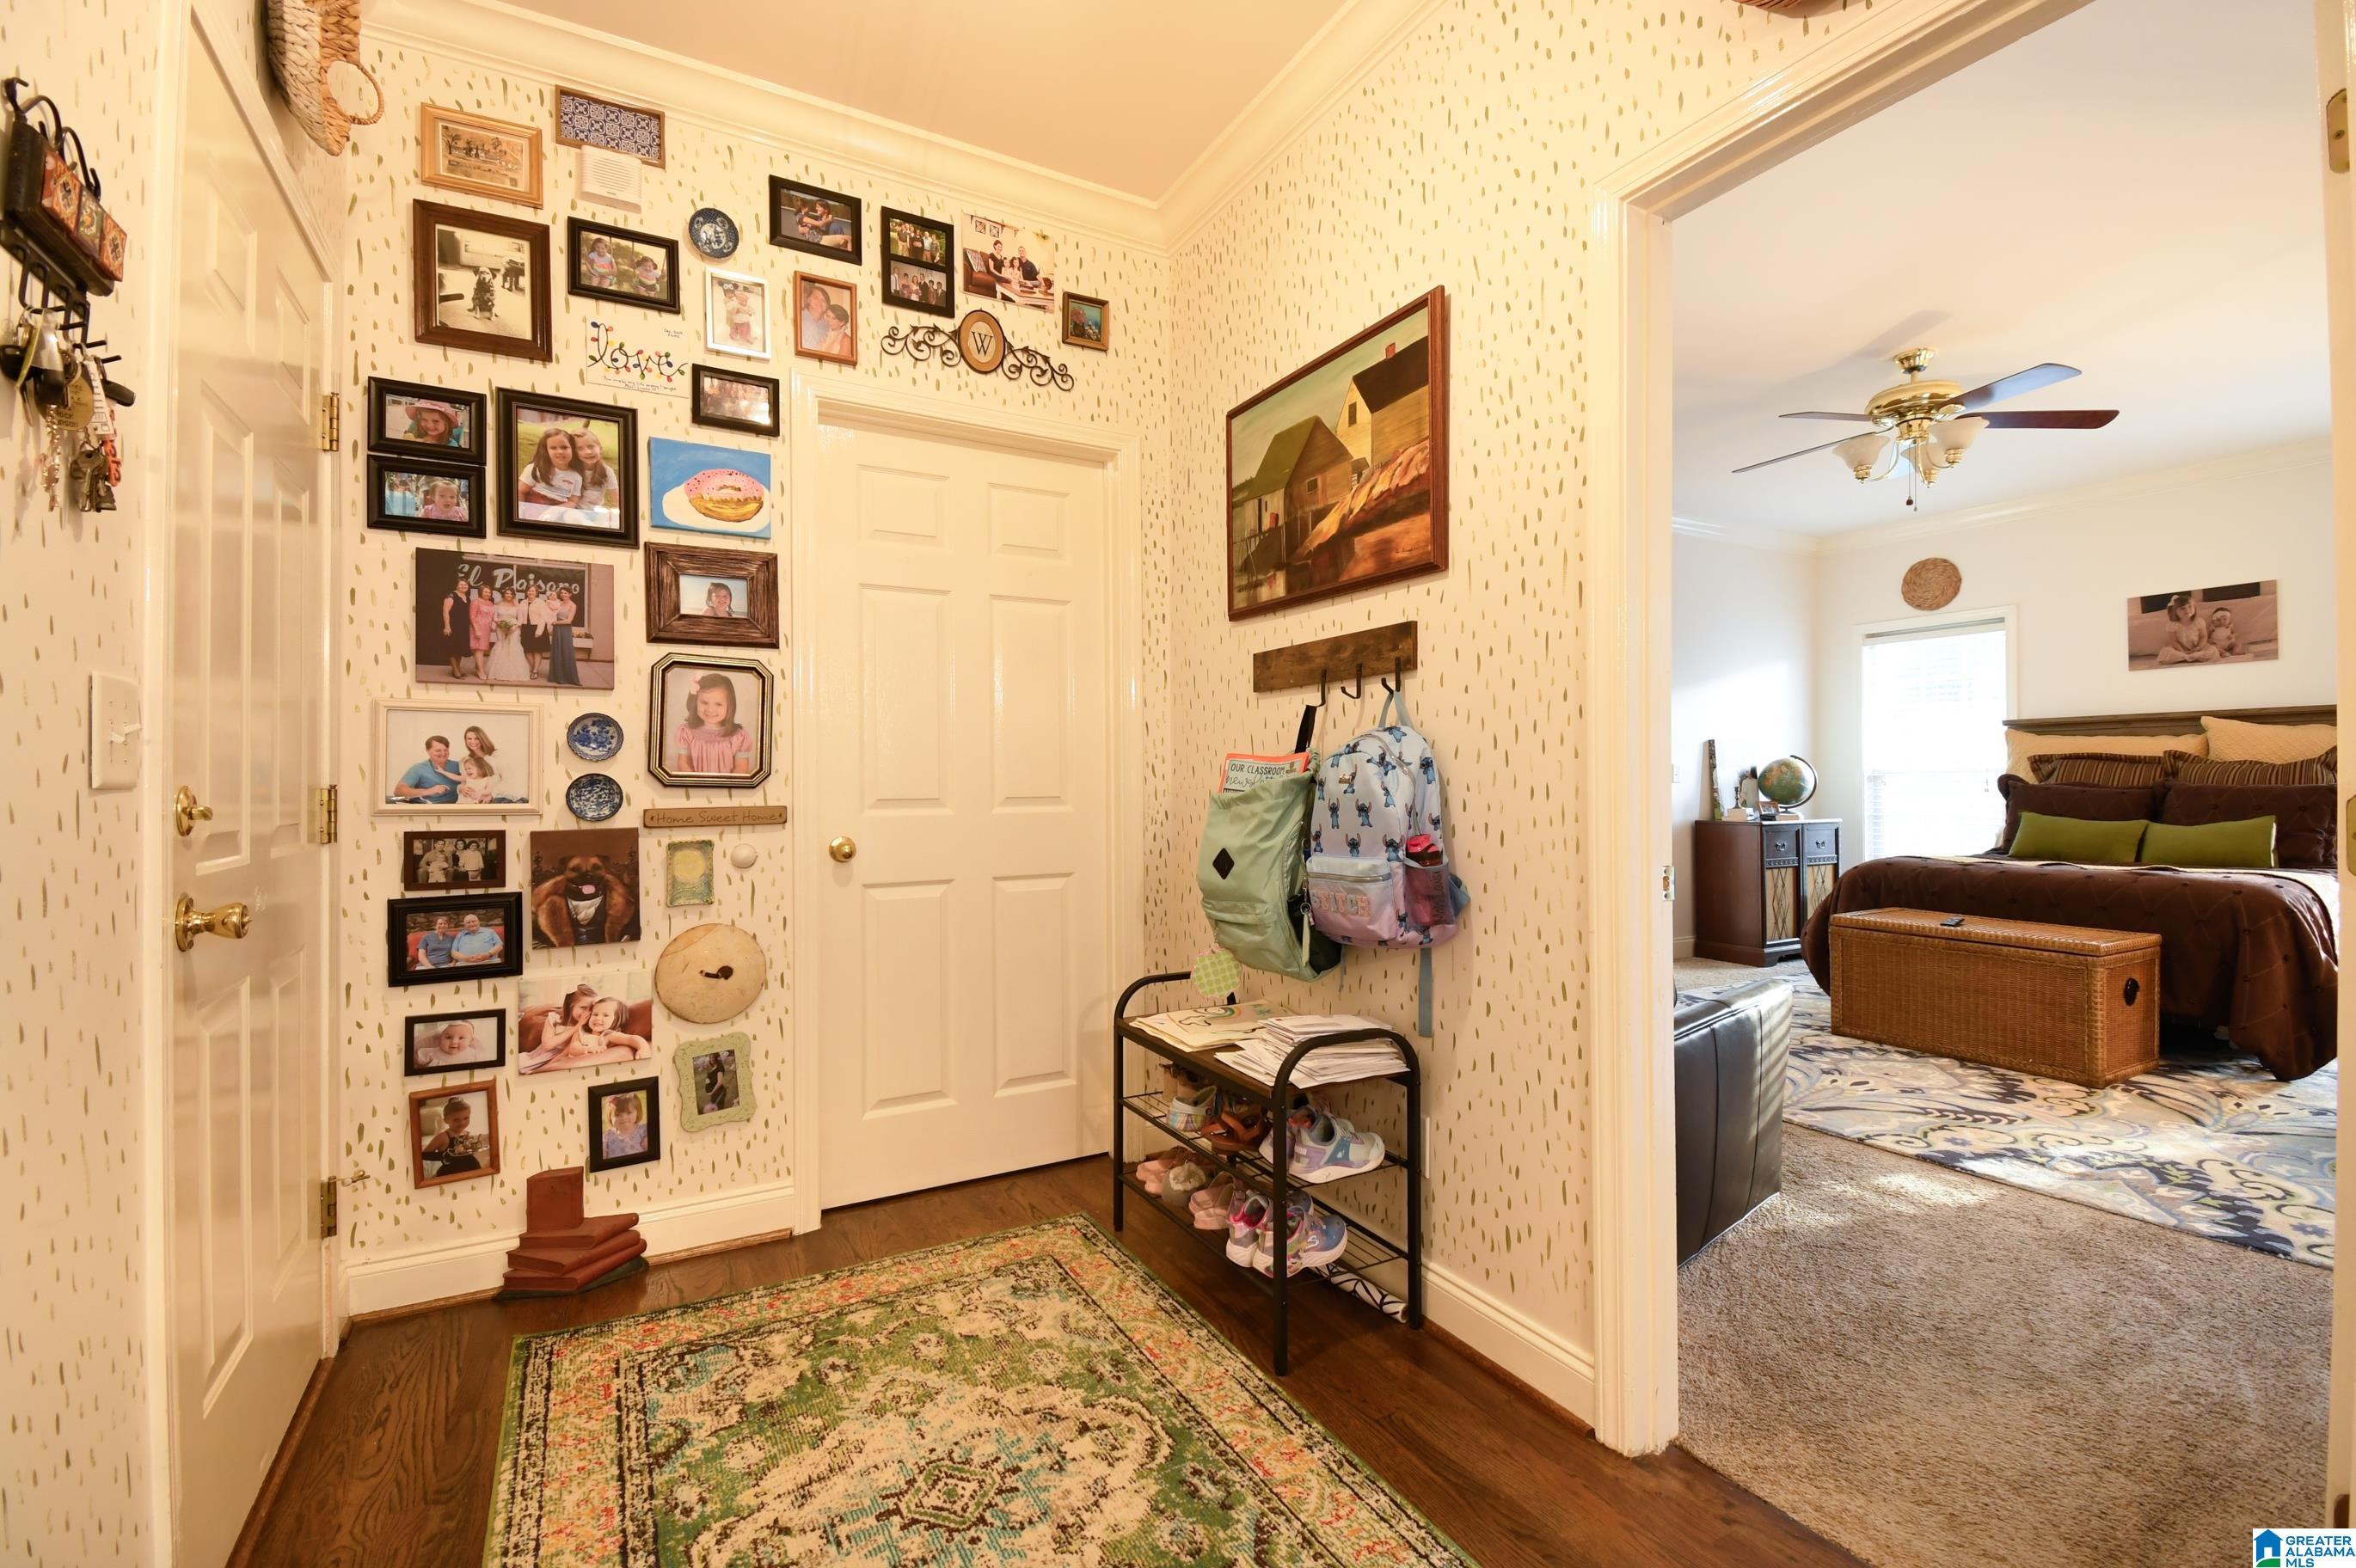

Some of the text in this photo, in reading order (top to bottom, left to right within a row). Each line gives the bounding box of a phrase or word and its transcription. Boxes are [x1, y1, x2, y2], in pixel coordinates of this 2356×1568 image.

[588, 322, 688, 377] love
[971, 331, 993, 357] W
[457, 563, 580, 595] El Paisano
[1230, 763, 1285, 775] OUR CLASSROOM
[657, 810, 778, 825] Home Sweet Home
